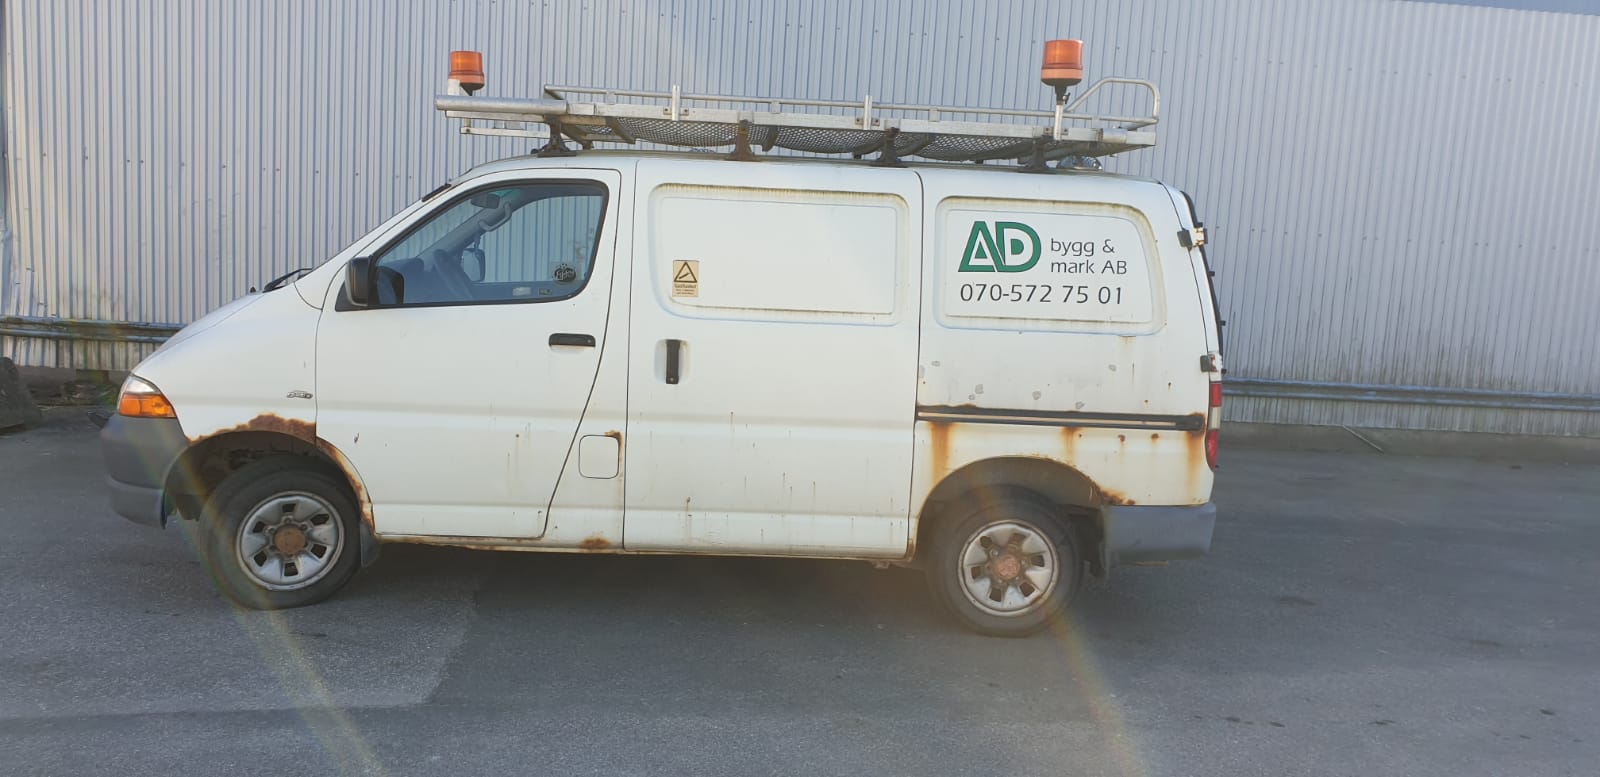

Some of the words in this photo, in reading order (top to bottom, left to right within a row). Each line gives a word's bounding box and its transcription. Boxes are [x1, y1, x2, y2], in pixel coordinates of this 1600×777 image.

[958, 221, 1042, 273] AD
[1051, 238, 1095, 257] bygg
[1102, 239, 1115, 254] &
[1050, 259, 1095, 275] mark
[1101, 260, 1128, 275] AB
[960, 283, 1053, 303] 070-572
[1062, 285, 1089, 304] 75
[1098, 286, 1122, 305] 01
